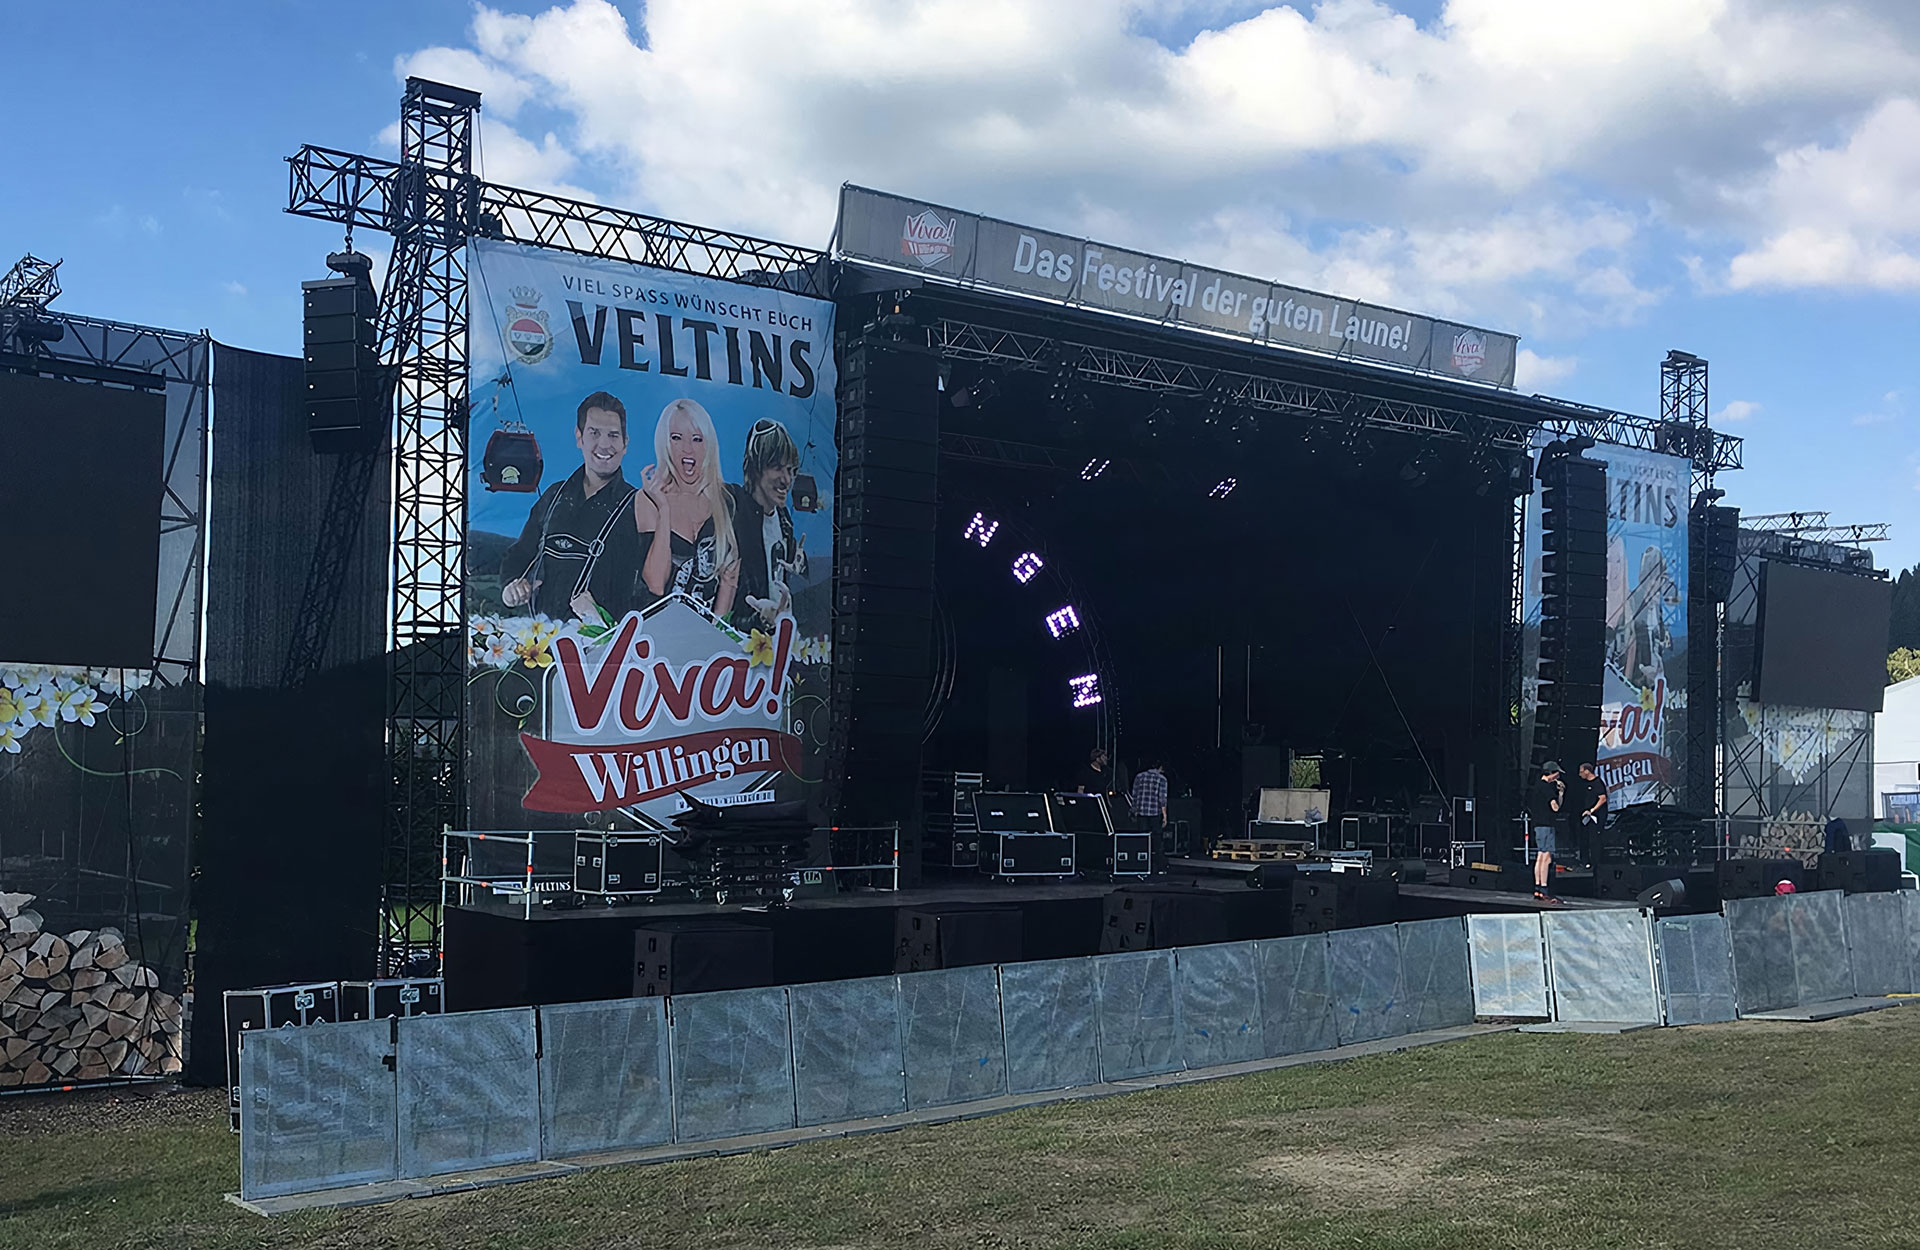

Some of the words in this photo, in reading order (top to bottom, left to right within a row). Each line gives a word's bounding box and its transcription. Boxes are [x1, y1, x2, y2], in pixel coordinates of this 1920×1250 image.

[907, 216, 956, 242] Viva!
[562, 274, 606, 296] VIEL
[613, 282, 669, 306] SPASS
[674, 293, 762, 323] WÜNSCHT
[768, 310, 813, 332] EUCH
[1012, 233, 1075, 283] Das
[1082, 248, 1198, 308] Festival
[1202, 277, 1248, 318] der
[1248, 296, 1324, 338] guten
[1329, 304, 1413, 352] Laune!
[565, 299, 816, 399] VELTINS
[554, 614, 795, 732] Viva!
[569, 737, 772, 805] Willingen
